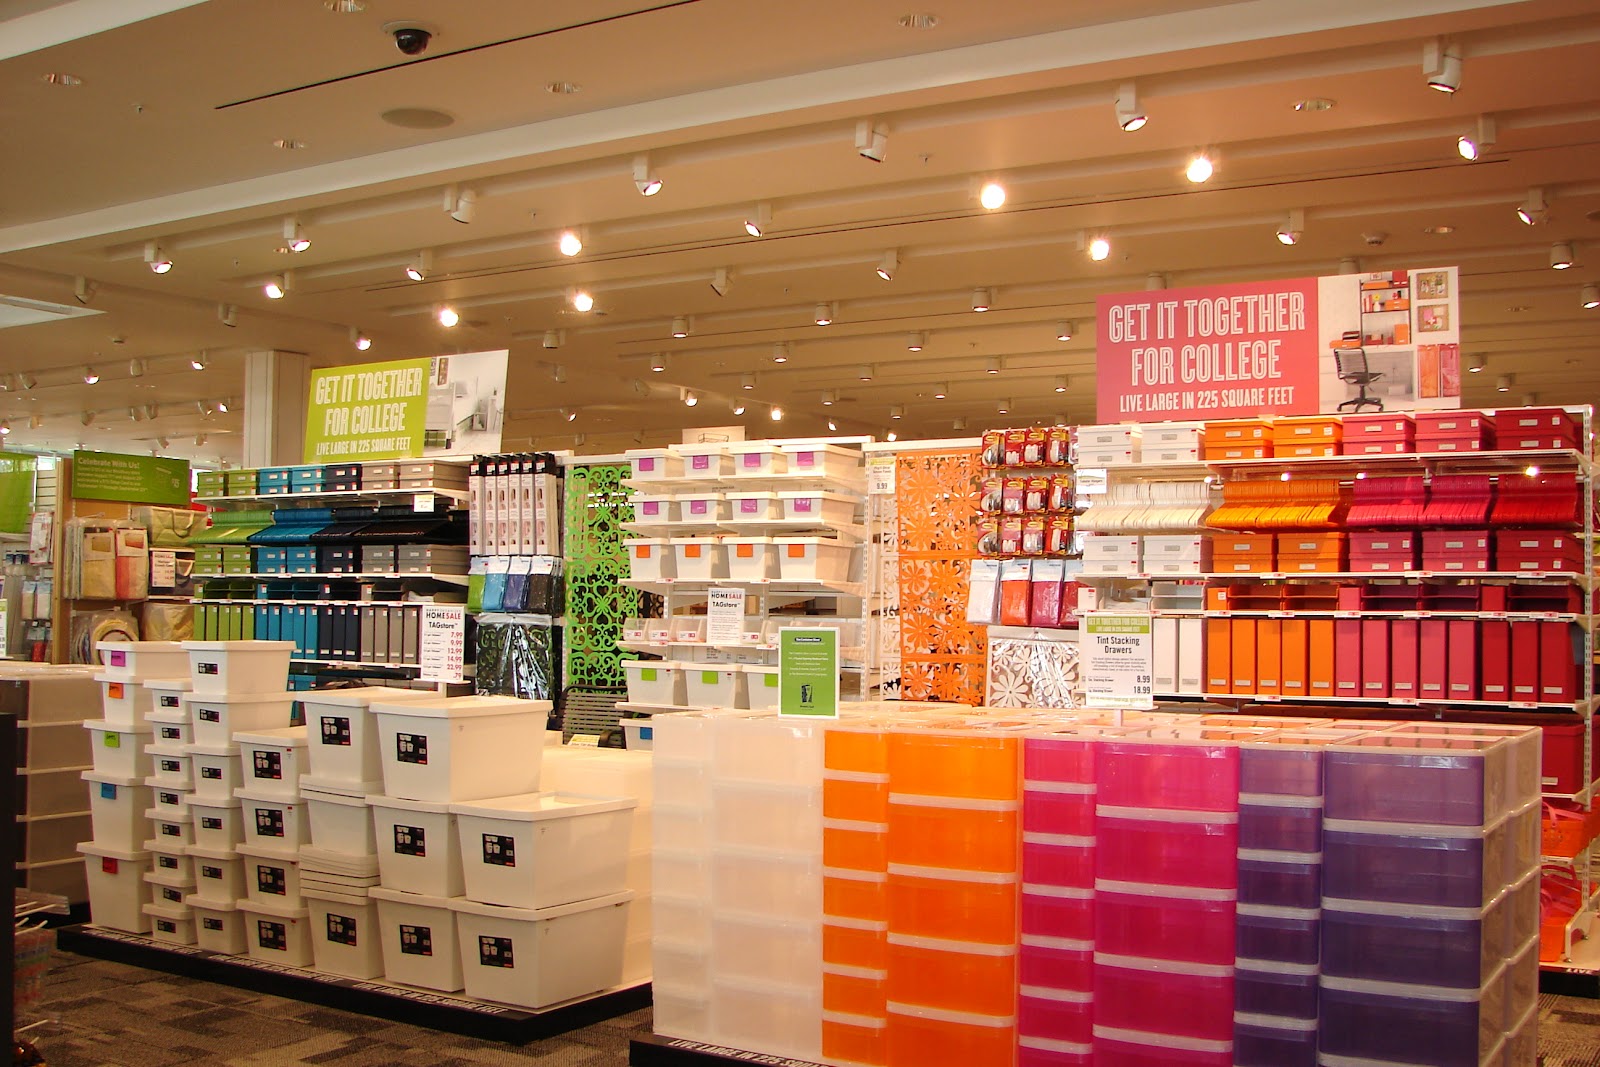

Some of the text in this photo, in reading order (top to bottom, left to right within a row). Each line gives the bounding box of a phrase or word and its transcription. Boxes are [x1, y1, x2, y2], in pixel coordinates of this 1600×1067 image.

[1108, 292, 1306, 343] GET IT TOGETHER
[1132, 340, 1282, 386] FOR COLLEGE
[316, 368, 423, 405] GET IT TOGETHER
[1120, 386, 1294, 412] LIVE LARGE IN 225 SQUARE FEET
[324, 402, 408, 436] FOR COLLEGE
[316, 436, 412, 456] LIVE LARGE IN 225 SQUARE FEET
[78, 458, 111, 467] Celebrate
[1097, 636, 1140, 646] Tint Stacking
[1105, 646, 1132, 654] Drawers
[668, 1039, 701, 1050] LIVE
[696, 1044, 742, 1057] LARGE
[752, 1055, 785, 1064] 225
